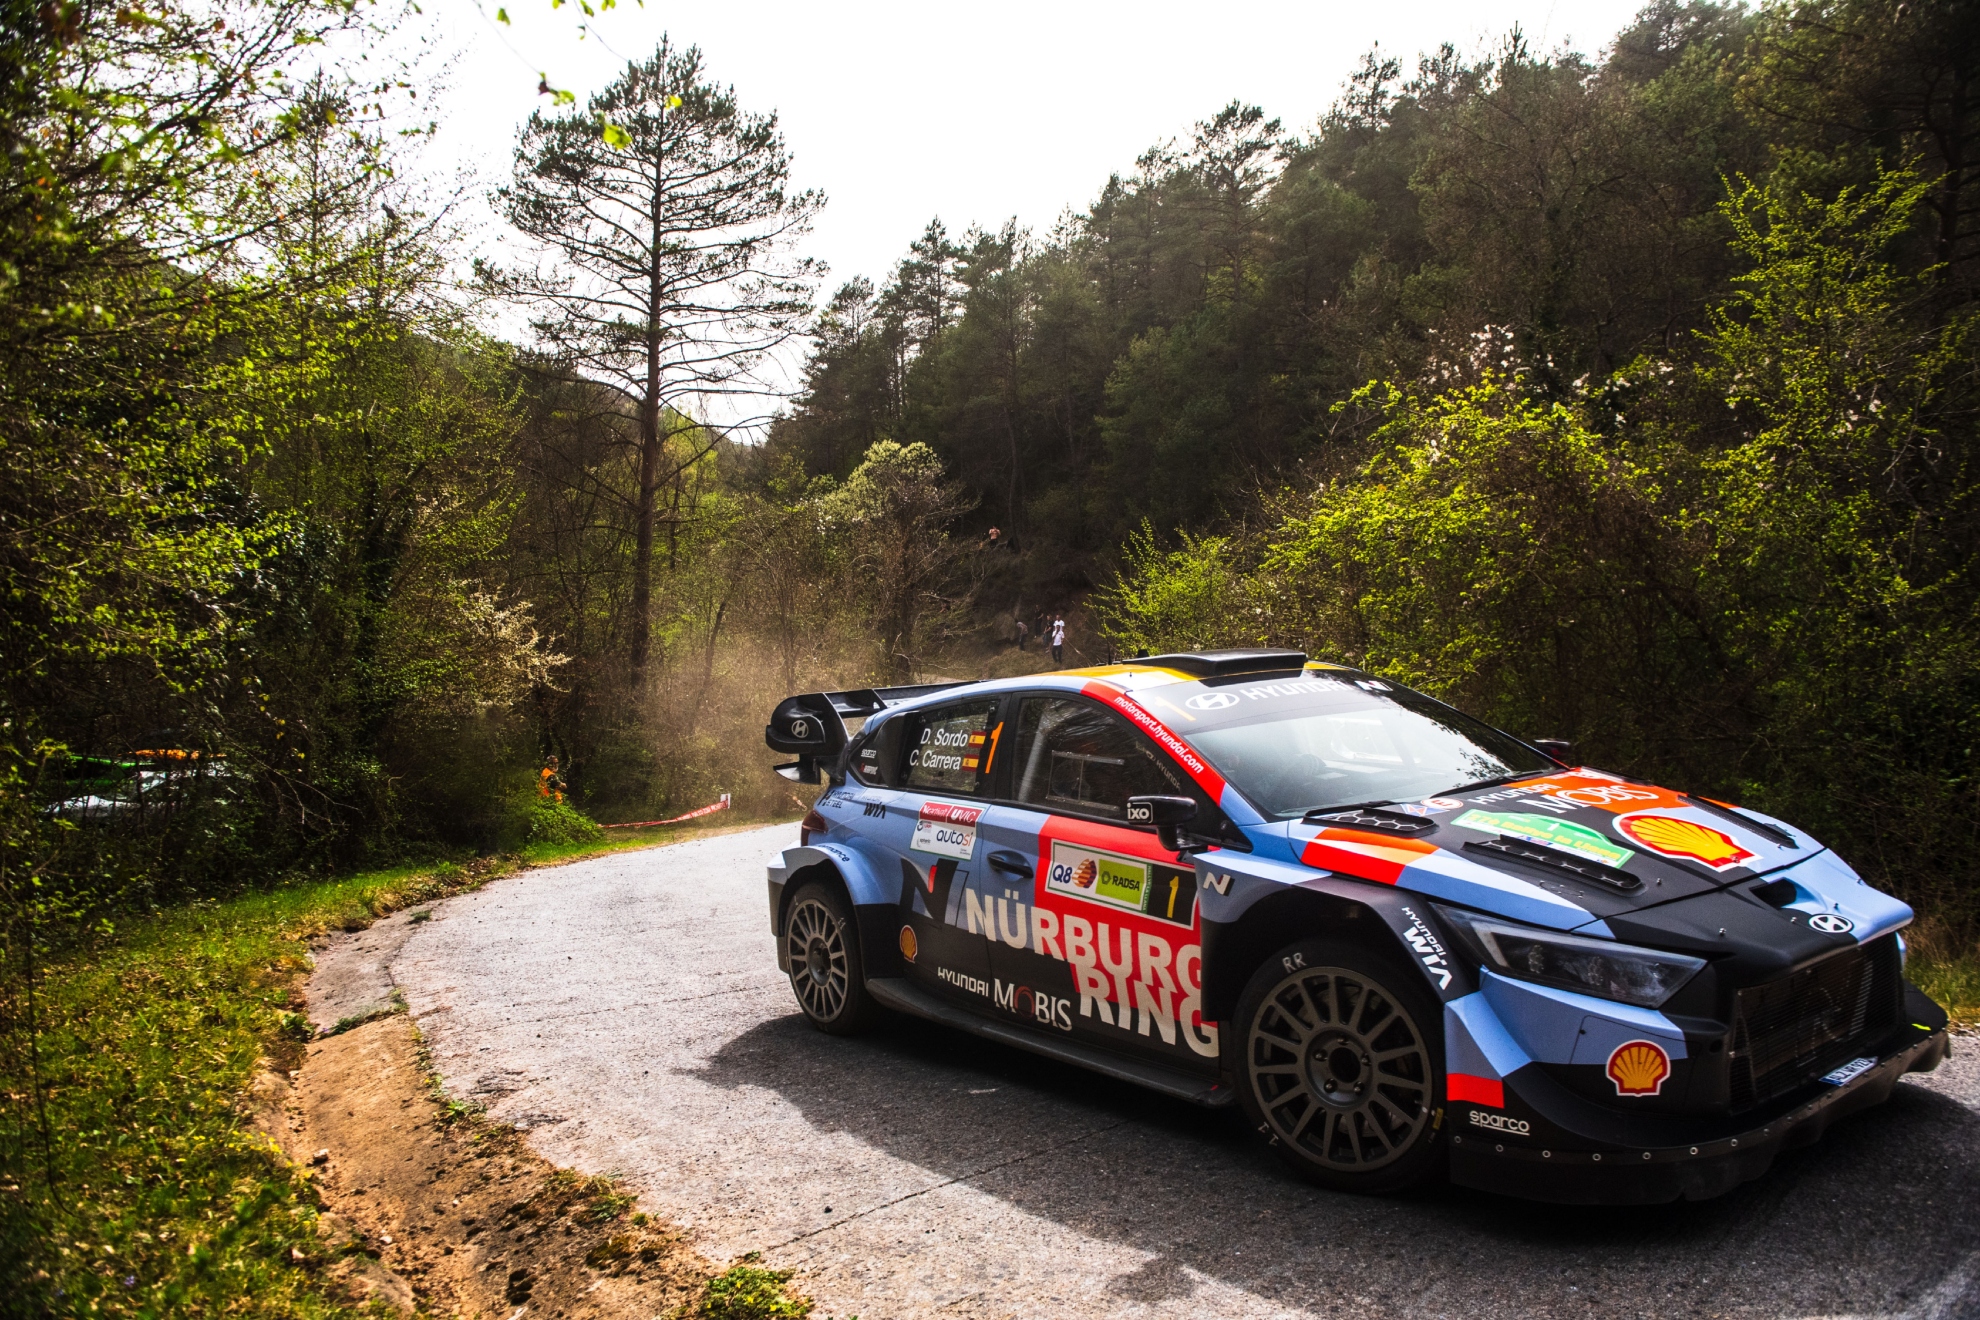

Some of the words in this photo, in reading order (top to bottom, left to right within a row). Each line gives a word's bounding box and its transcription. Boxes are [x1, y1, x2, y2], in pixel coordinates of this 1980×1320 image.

[1239, 680, 1354, 700] HYUNDAI
[920, 728, 931, 745] D.
[934, 728, 968, 747] Sordo
[1114, 696, 1204, 774] motorsport.hyundai.com
[985, 721, 1004, 774] 1
[909, 749, 919, 766] C.
[922, 750, 961, 770] Carrera
[1467, 783, 1562, 805] HYUNDAI
[1516, 785, 1659, 814] MOBIS
[951, 809, 976, 823] UVIC
[1126, 802, 1149, 820] ixo
[1052, 864, 1073, 884] Q8
[1112, 875, 1140, 892] RADSA
[1166, 876, 1179, 918] 1
[1401, 907, 1446, 956] HYUNDAI
[1282, 952, 1307, 974] RR
[937, 966, 989, 997] HYUNDAI
[993, 978, 1072, 1031] MOBIS
[1078, 964, 1219, 1058] RING
[1469, 1110, 1530, 1135] sparco
